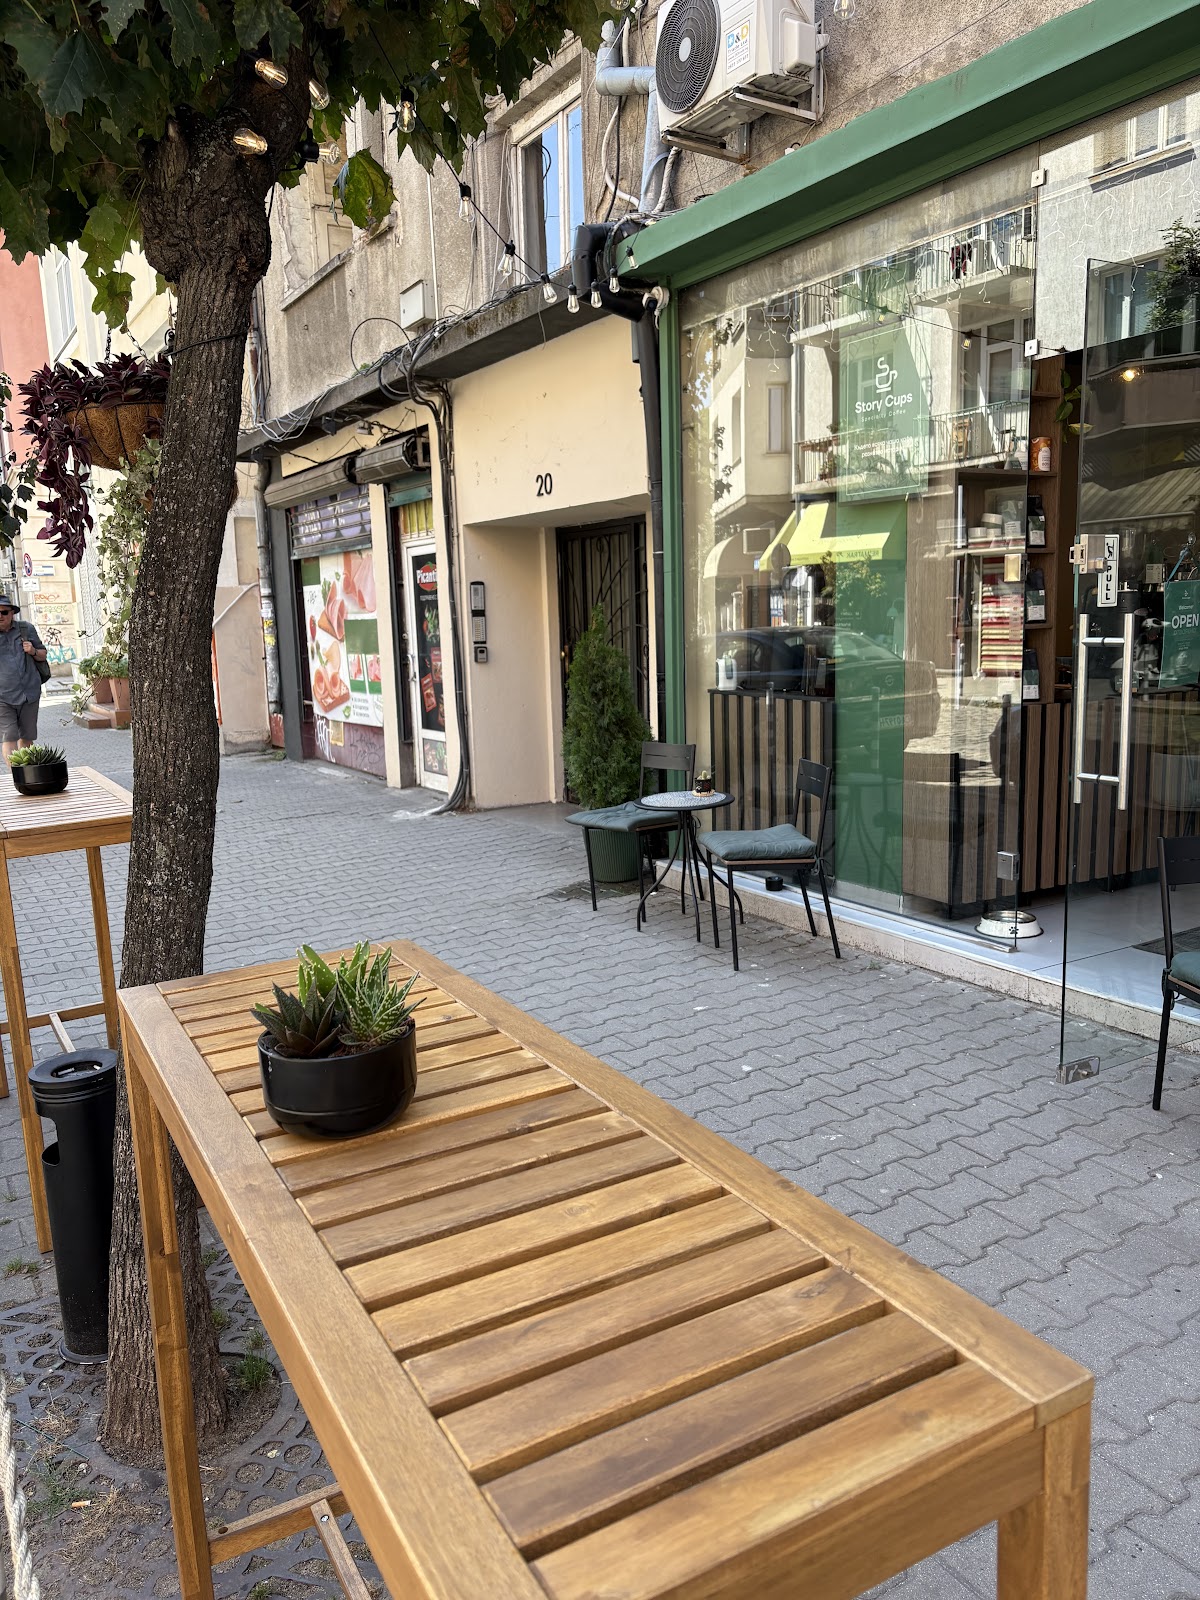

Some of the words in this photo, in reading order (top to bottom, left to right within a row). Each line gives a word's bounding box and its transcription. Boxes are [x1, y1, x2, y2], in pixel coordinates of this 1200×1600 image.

[855, 399, 883, 414] Story
[885, 393, 913, 408] Cups
[888, 409, 906, 417] Coffee
[535, 472, 553, 497] 20
[1105, 565, 1113, 601] PULL
[1171, 613, 1200, 630] OPEN
